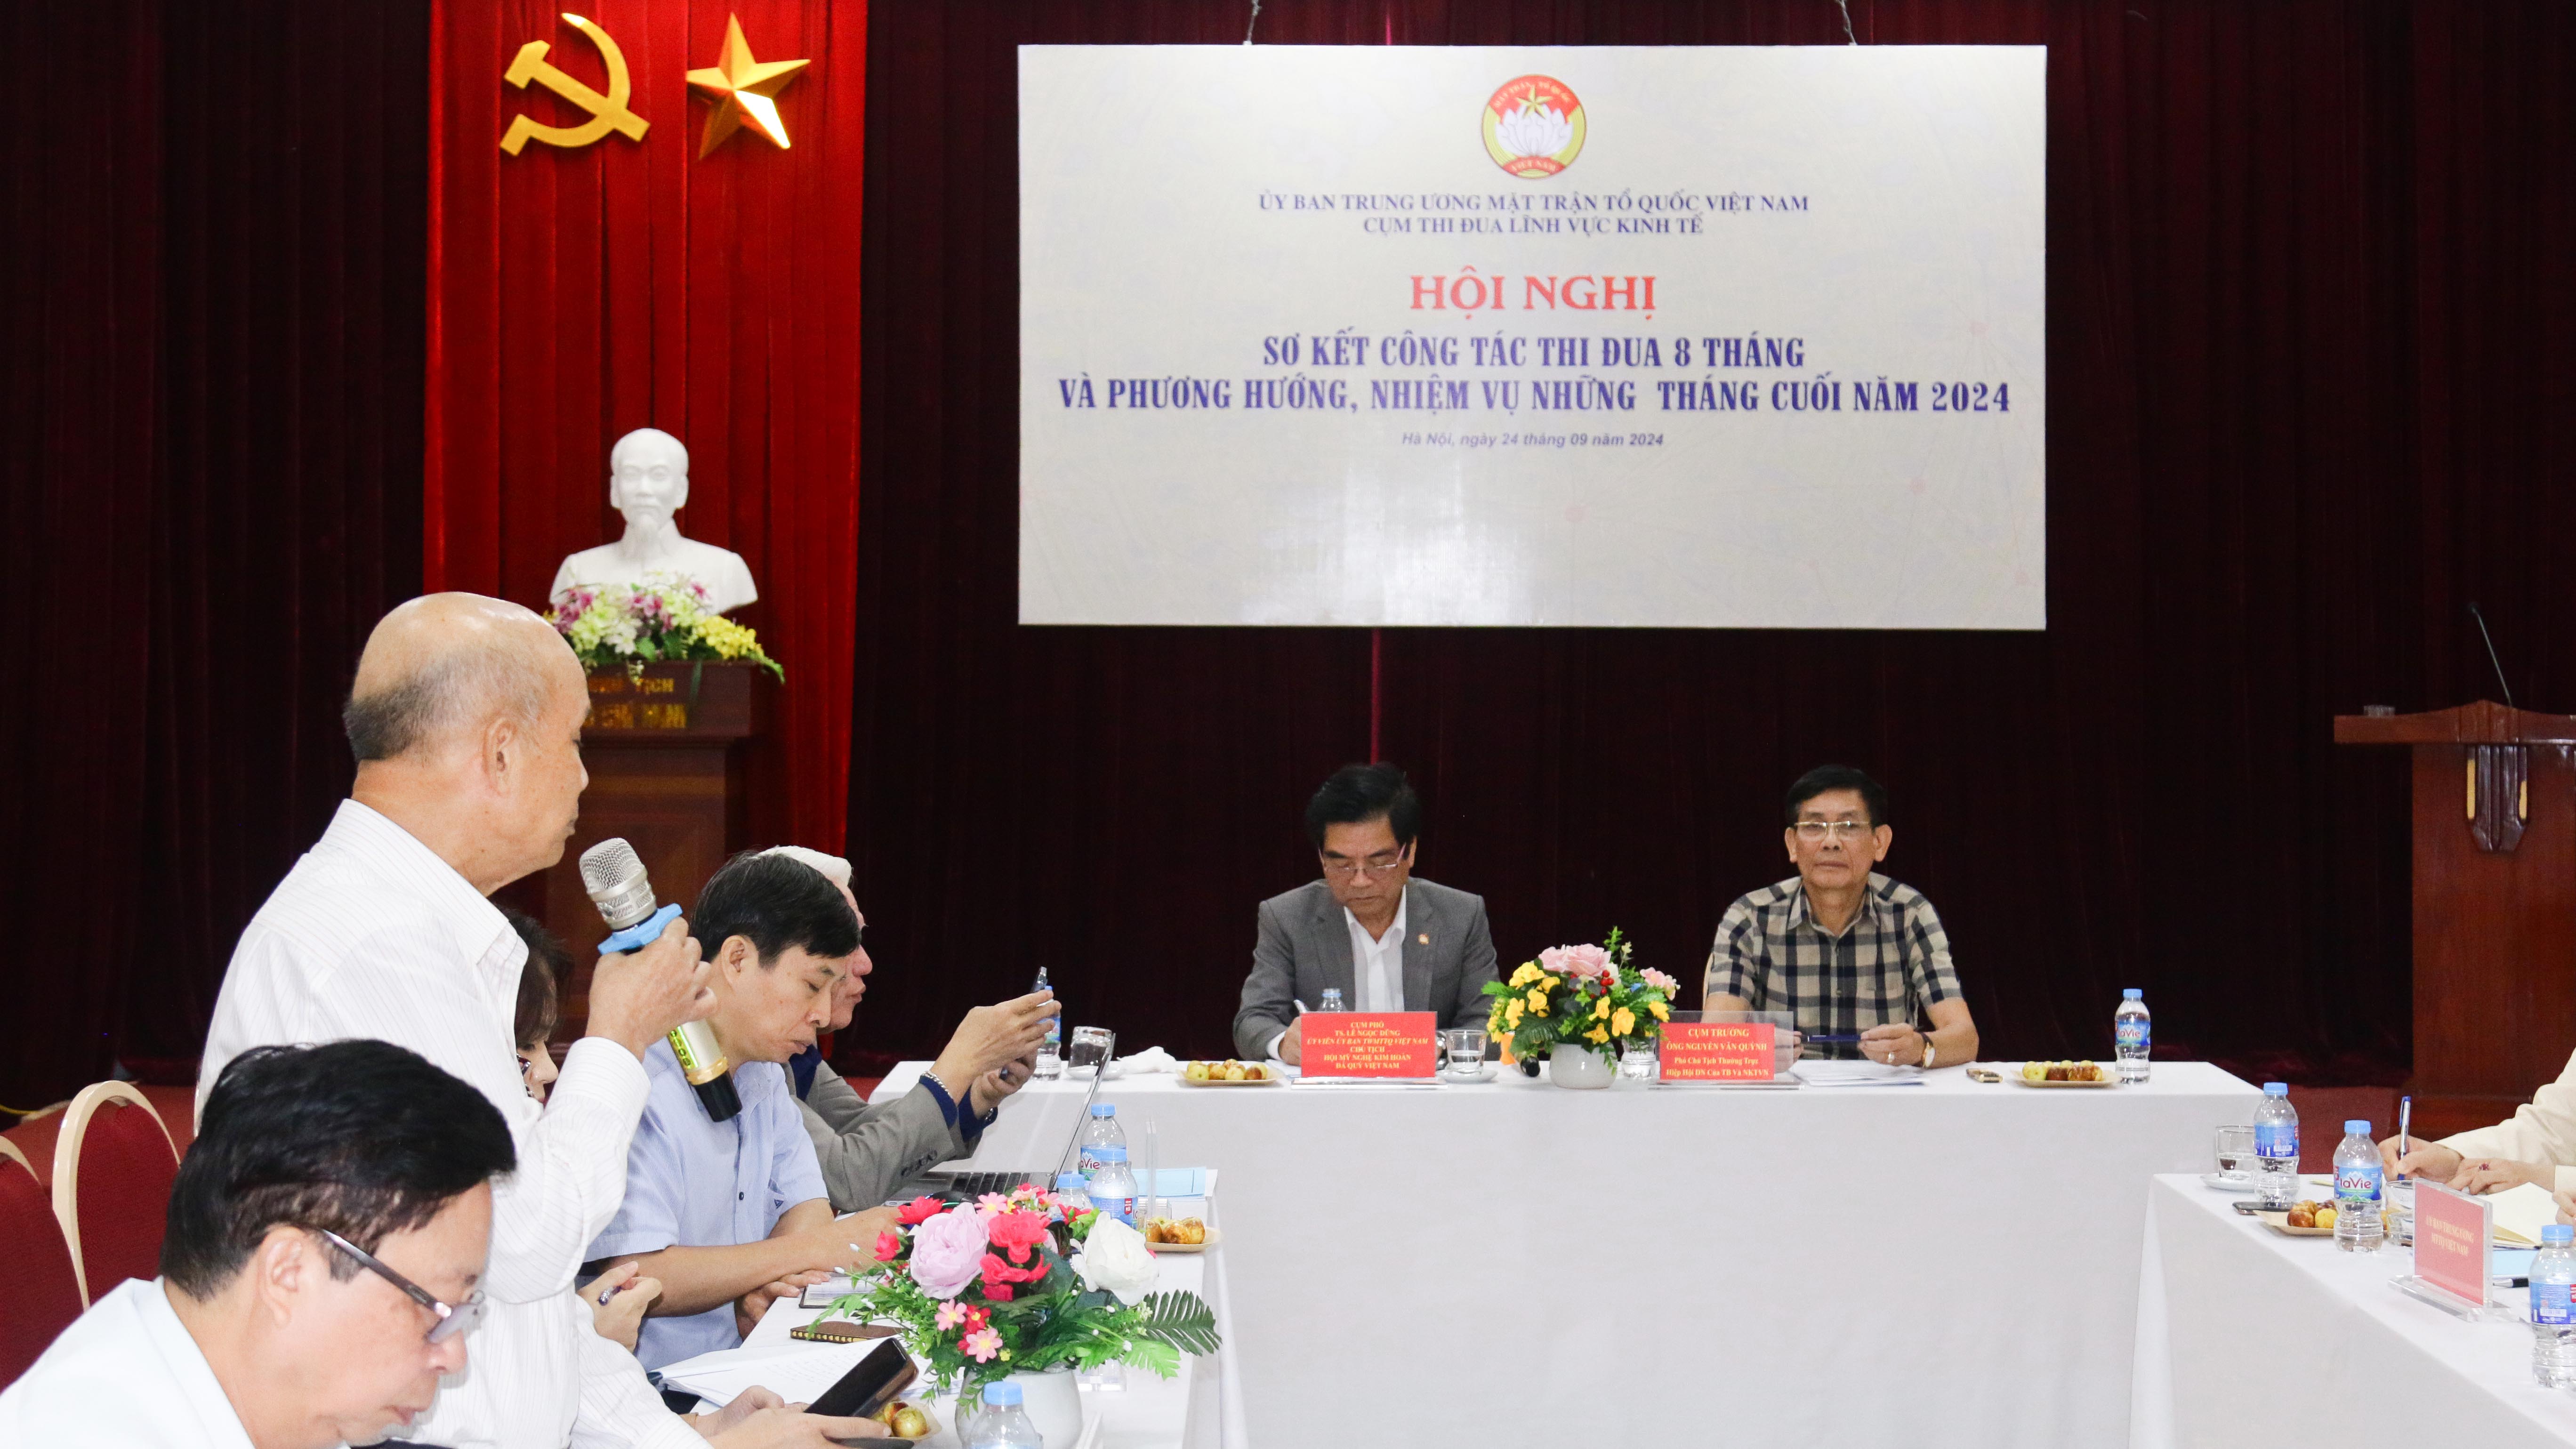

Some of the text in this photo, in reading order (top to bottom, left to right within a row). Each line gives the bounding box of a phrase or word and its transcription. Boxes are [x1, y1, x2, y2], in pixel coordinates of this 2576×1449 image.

[1259, 188, 1809, 215] ỦY BAN TRUNG ƯƠNG MẶT TRẬN TỔ QUỐC VIỆT NAM
[1363, 212, 1704, 238] CỤM THI ĐUA LĨNH VỰC KINH TẾ
[1410, 265, 1657, 321] HỘI NGHỊ
[1264, 329, 1805, 369] SƠ KẾT CÔNG TÁC THI ĐUA 8 THÁNG
[1059, 372, 2010, 416] VÀ PHƯƠNG HƯỚNG, NHIỆM VỤ NHỮNG THÁNG CUỐI NĂM 2024
[1402, 433, 1422, 445] Hà
[1460, 433, 1498, 448] ngày
[1501, 433, 1519, 445] 24
[1523, 433, 1566, 449] tháng
[1570, 433, 1588, 445] 09
[1592, 433, 1625, 445] năm
[1629, 433, 1665, 445] 2024
[1350, 1021, 1368, 1030] CỤM
[1346, 1028, 1356, 1037] LÊ
[1357, 1030, 1377, 1038] NGỌC
[1688, 1028, 1709, 1038] CỤM
[1666, 1041, 1684, 1050] ÔNG
[1720, 1041, 1737, 1050] VĂN
[1702, 1057, 1716, 1065] Tịch
[2340, 1177, 2371, 1189] laVie
